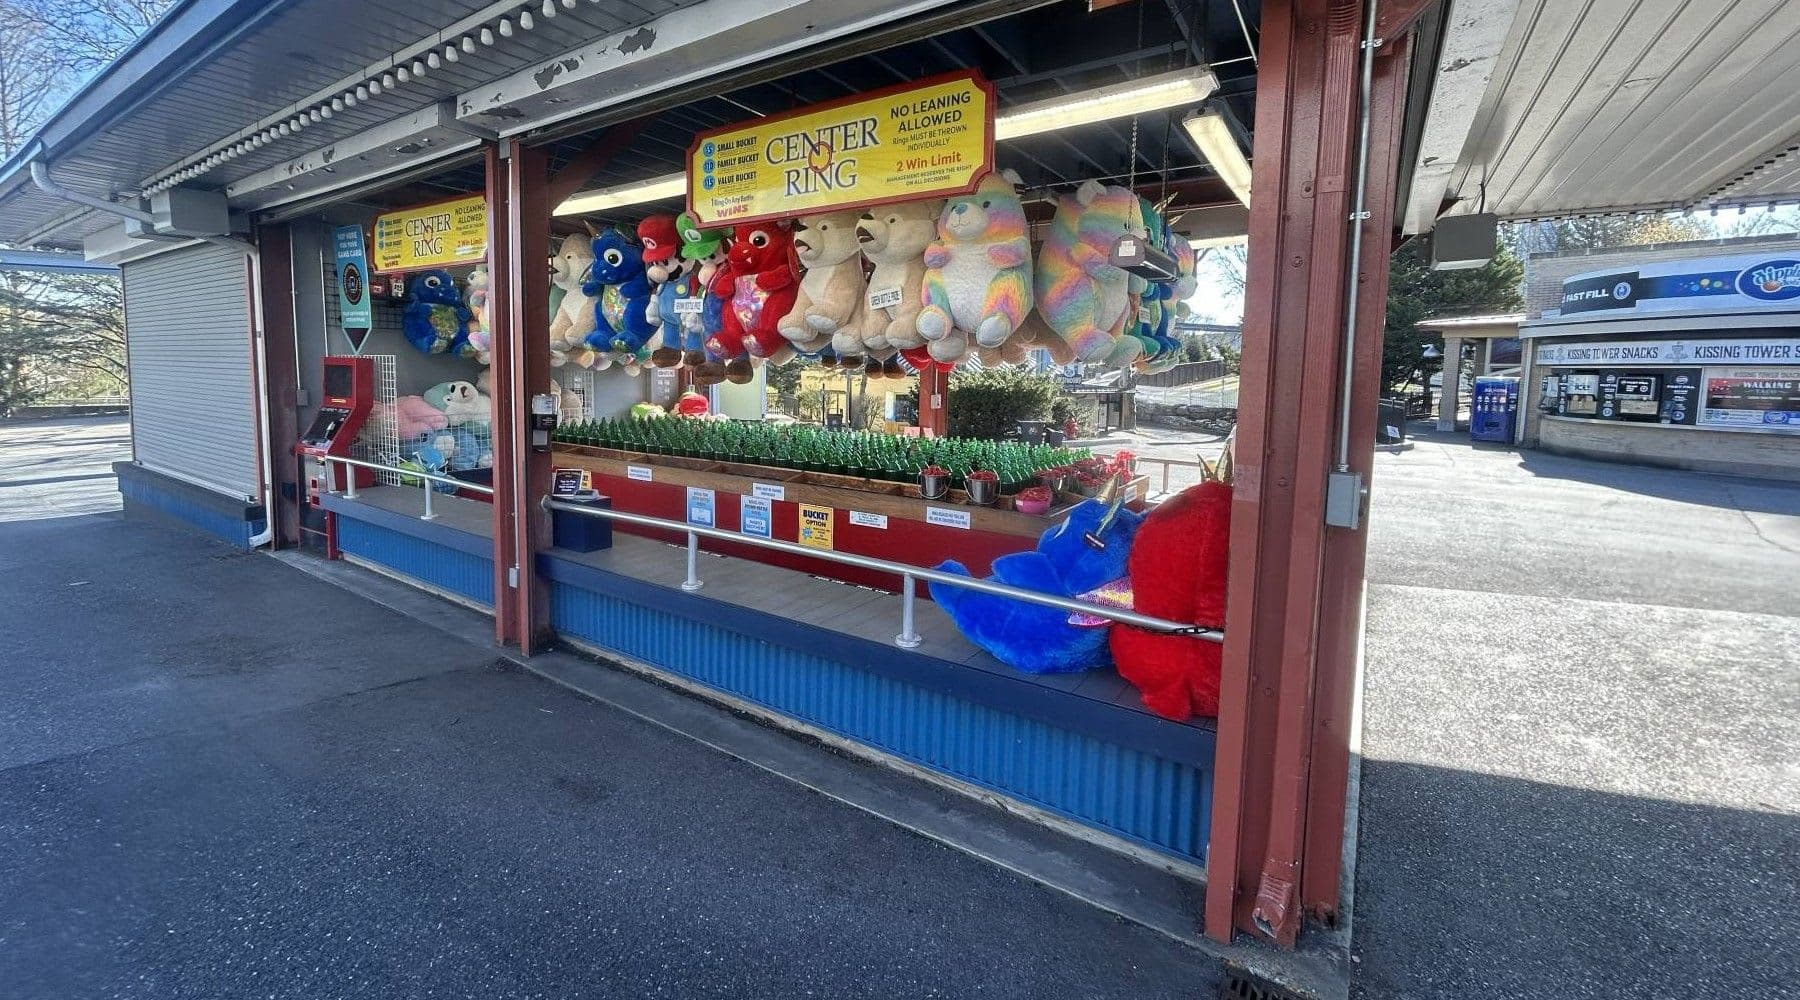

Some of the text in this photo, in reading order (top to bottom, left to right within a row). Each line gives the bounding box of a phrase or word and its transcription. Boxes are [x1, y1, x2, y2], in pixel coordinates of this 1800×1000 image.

[890, 91, 971, 119] NO LEANING
[898, 109, 962, 133] ALLOWED
[765, 117, 880, 165] CENTER
[909, 132, 928, 143] MUST
[929, 130, 938, 139] BE
[939, 123, 968, 137] THROWN
[717, 136, 758, 153] SMALL BUCKET
[907, 137, 950, 152] INDIVIDUALLY
[717, 157, 737, 169] FAMILY
[737, 153, 759, 165] BUCKET
[897, 151, 962, 173] 2 Win Limit
[717, 171, 757, 186] VALUE BUCKET
[784, 159, 857, 197] RING
[716, 204, 749, 217] WINS
[405, 213, 452, 238] CENTER
[414, 237, 443, 258] RING
[1566, 288, 1609, 303] FAST FILL
[1568, 349, 1591, 360] KISSING
[1592, 348, 1620, 360] TOWER
[1622, 347, 1659, 359] SNACKS
[1694, 345, 1740, 359] KISSING
[1744, 345, 1790, 359] TOWER
[1743, 381, 1792, 389] WALKING
[803, 510, 828, 521] BUCKET
[805, 519, 827, 528] OPTION
